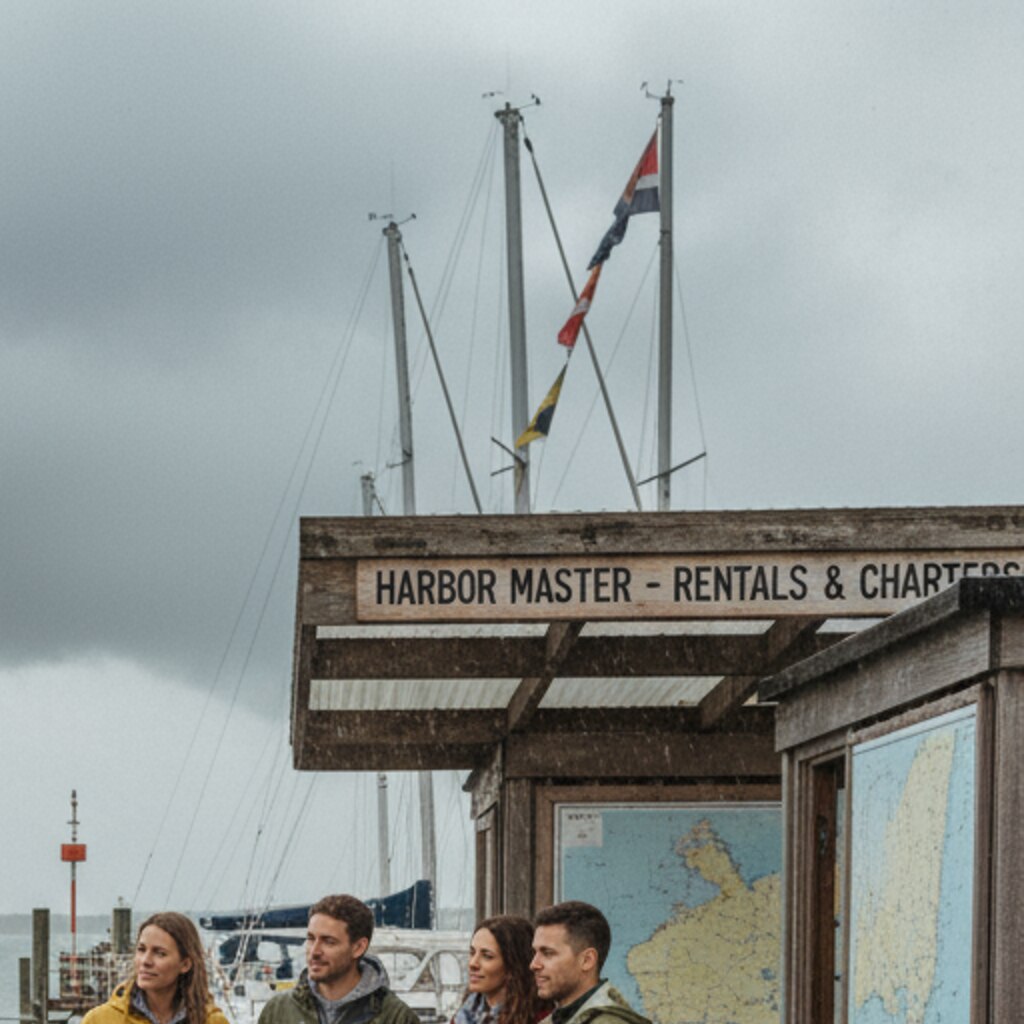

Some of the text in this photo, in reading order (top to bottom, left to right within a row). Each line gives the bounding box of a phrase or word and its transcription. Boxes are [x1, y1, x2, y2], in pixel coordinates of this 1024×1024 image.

[376, 568, 497, 605] HARBOR
[510, 567, 632, 603] MASTER
[673, 565, 808, 602] RENTALS
[824, 564, 845, 600] &
